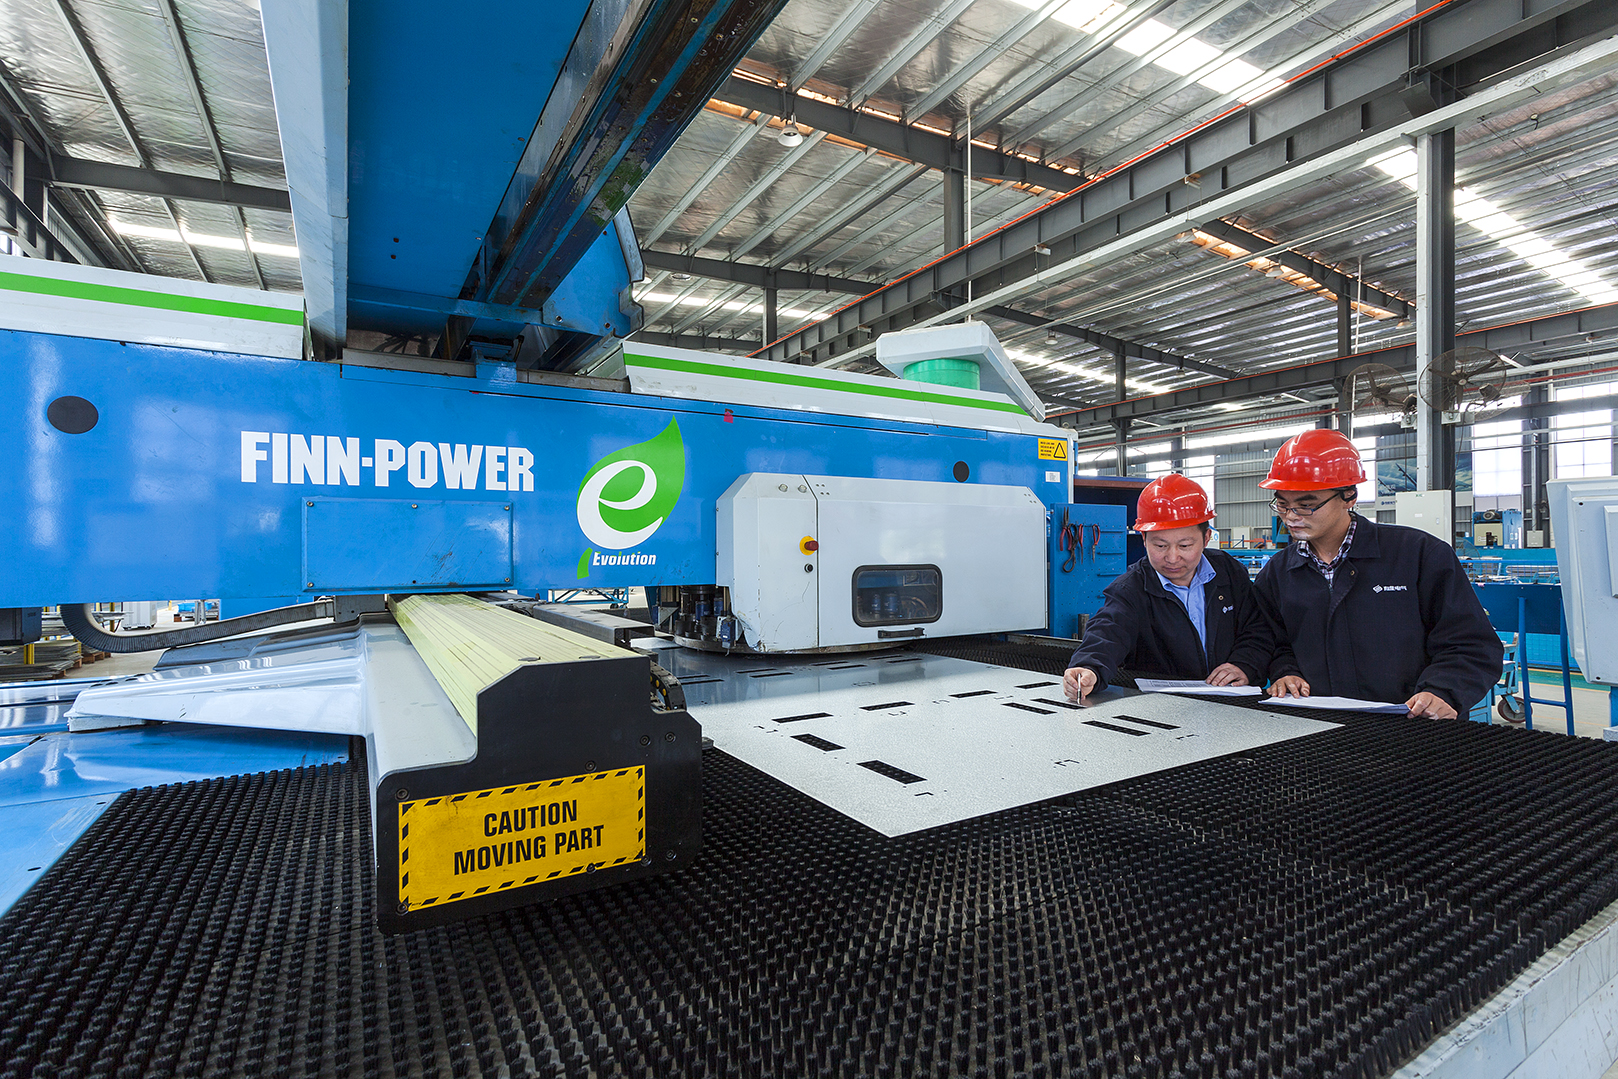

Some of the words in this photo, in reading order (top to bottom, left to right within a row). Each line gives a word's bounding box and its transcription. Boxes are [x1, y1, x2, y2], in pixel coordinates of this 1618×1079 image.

[241, 430, 535, 492] FINN-POWER
[592, 551, 657, 566] Evolution
[484, 800, 577, 837] CAUTION
[454, 836, 546, 875] MOVING
[555, 825, 604, 855] PART
